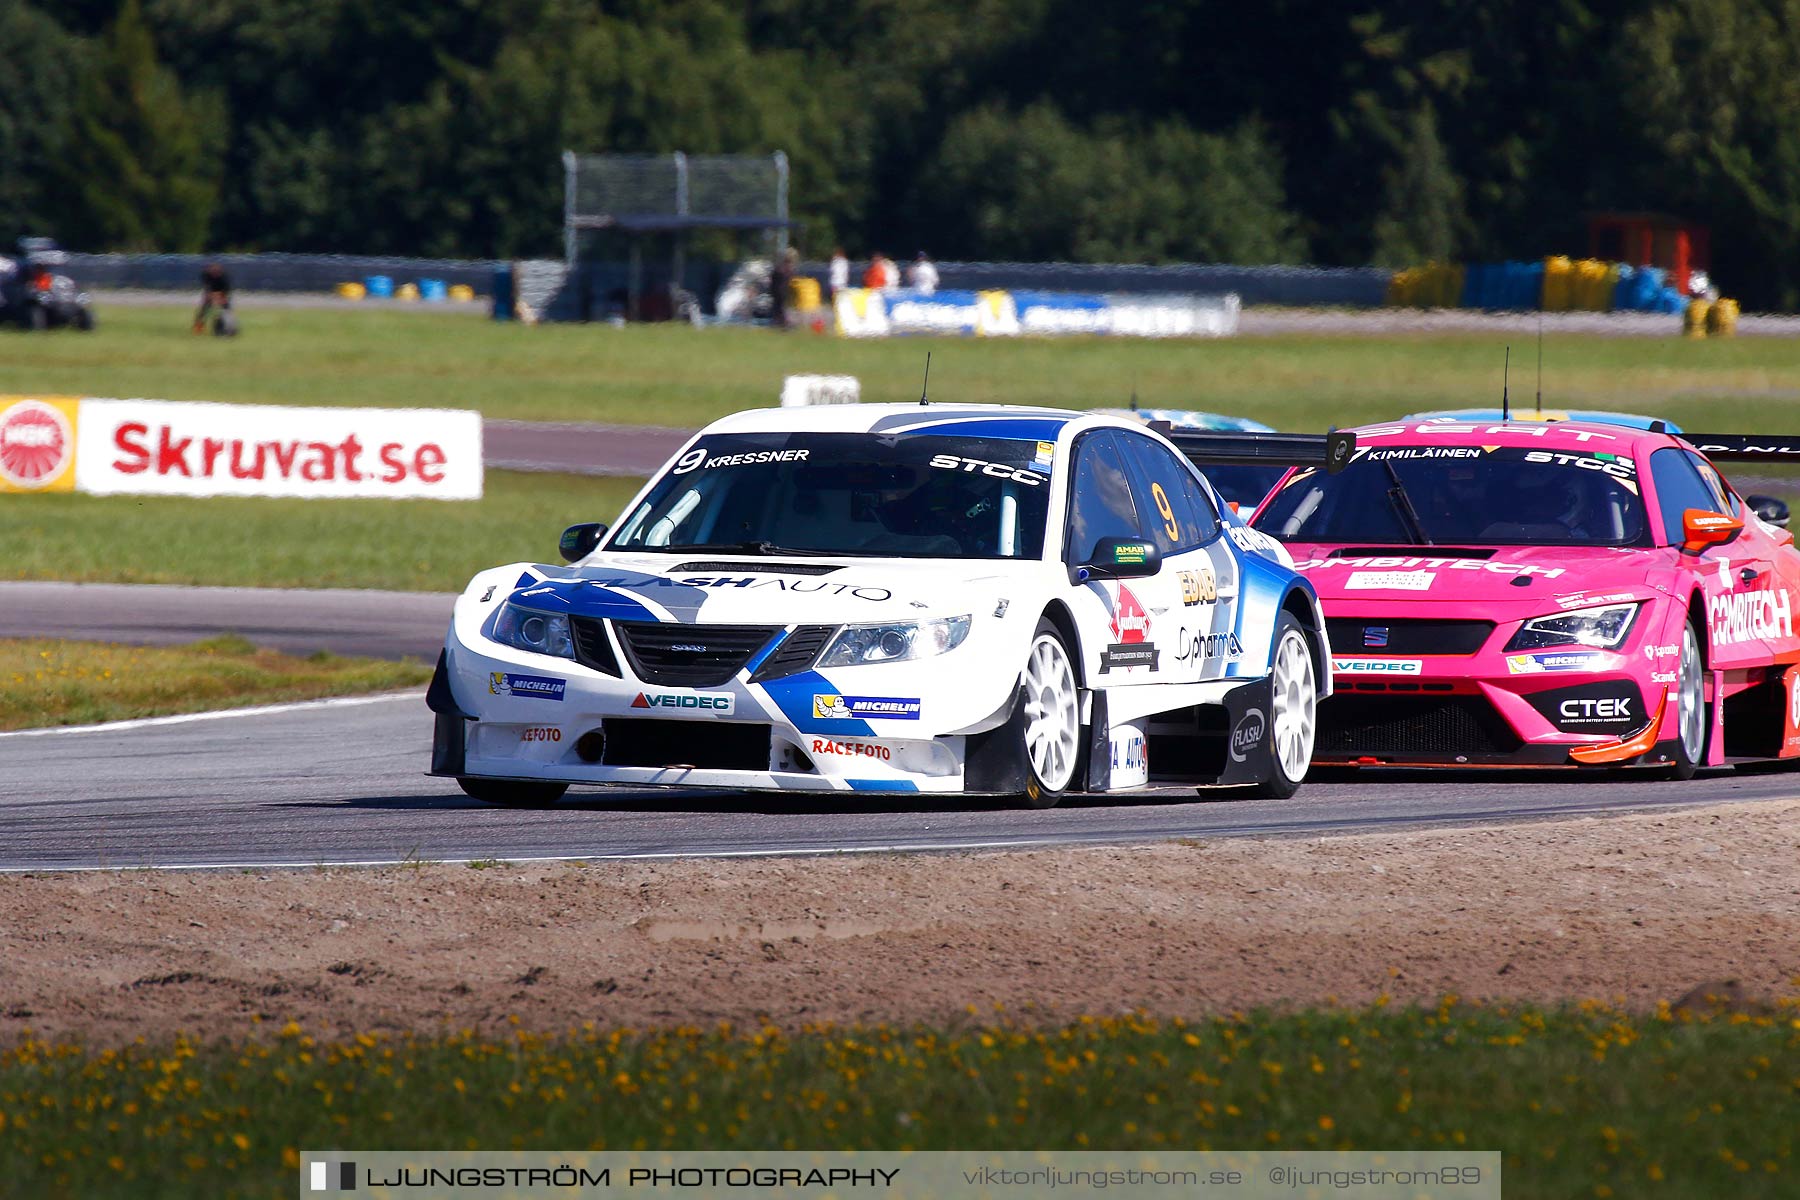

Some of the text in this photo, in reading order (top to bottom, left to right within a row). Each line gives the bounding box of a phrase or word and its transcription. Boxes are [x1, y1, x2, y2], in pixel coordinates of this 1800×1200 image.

[112, 421, 447, 483] Skruvat.se
[673, 448, 810, 475] 9 KRESSNER
[1368, 447, 1480, 461] KIMILÄINEN
[929, 454, 1044, 486] STCC
[1524, 451, 1631, 478] STCC
[1151, 482, 1179, 542] 9
[1176, 568, 1217, 606] EDAB
[1711, 588, 1793, 646] COMBITECH
[1337, 662, 1416, 671] VEIDEC
[512, 680, 565, 693] MICHELIN
[645, 694, 730, 710] VEIDEC
[853, 701, 920, 712] MICHELIN
[1560, 698, 1632, 717] CTEK
[1234, 725, 1260, 747] FLASH
[812, 739, 891, 761] RACEFOTO
